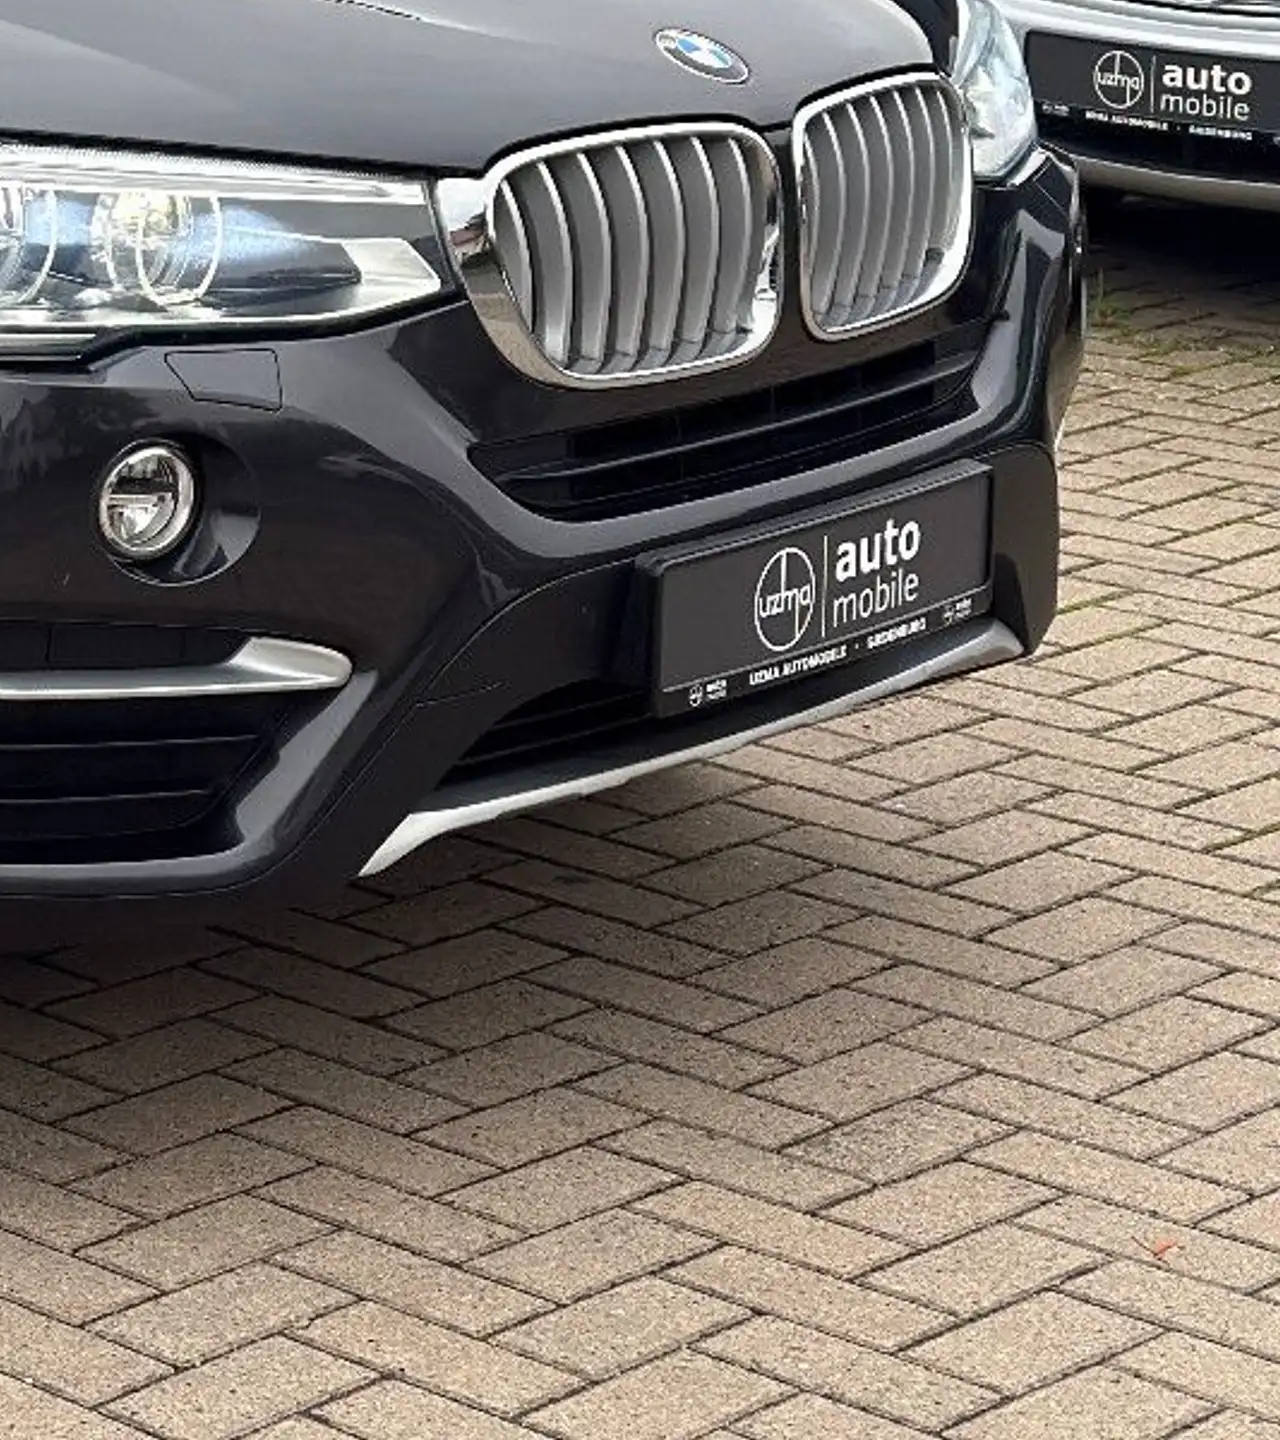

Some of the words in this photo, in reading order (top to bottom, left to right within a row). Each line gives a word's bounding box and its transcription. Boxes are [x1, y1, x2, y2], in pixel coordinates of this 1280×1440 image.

[1161, 63, 1253, 97] auto
[1159, 93, 1251, 122] mobile
[835, 518, 921, 583] auto
[831, 566, 920, 628] mobile
